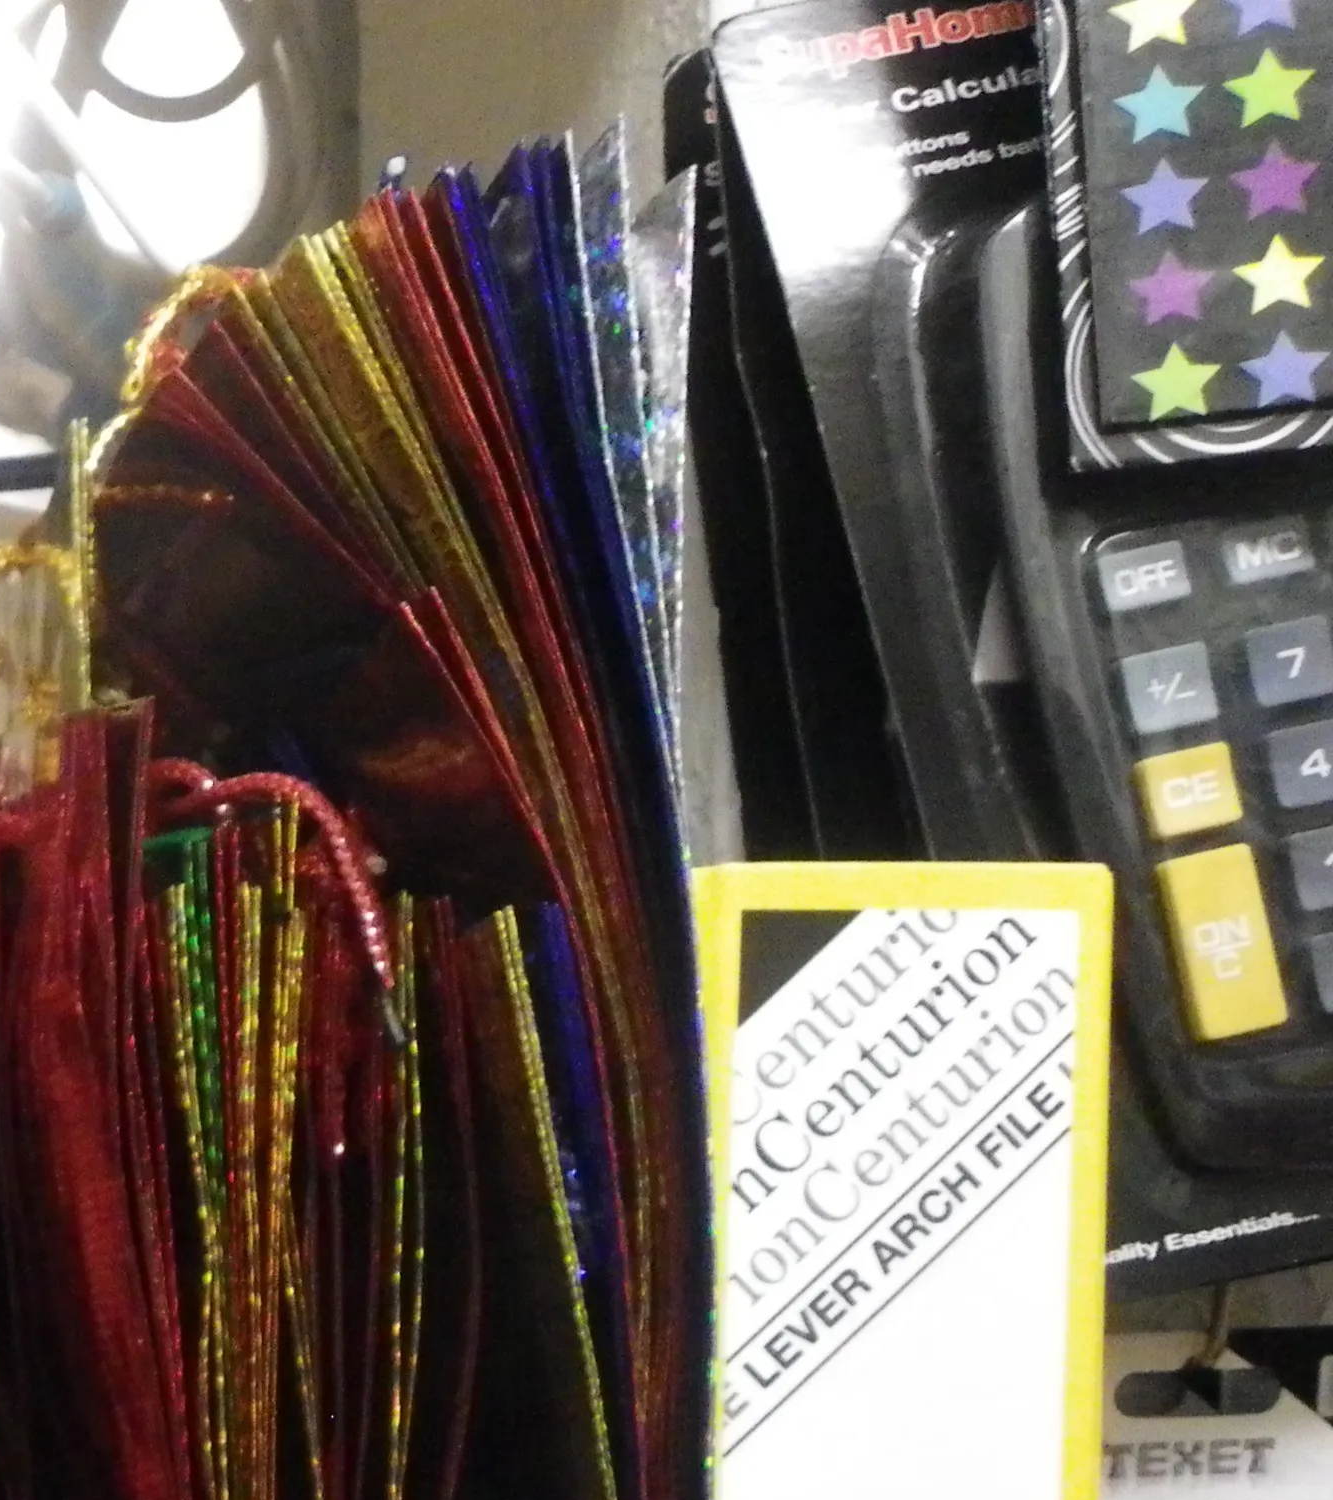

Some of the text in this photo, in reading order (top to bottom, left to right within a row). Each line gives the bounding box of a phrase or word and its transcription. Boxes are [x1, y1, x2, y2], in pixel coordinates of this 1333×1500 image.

[912, 148, 995, 178] needs
[1115, 531, 1303, 597] OFF MC
[1276, 646, 1307, 680] 7
[1162, 748, 1332, 809] CE 4
[742, 1268, 872, 1389] LEVER
[871, 1161, 983, 1276] ARCH
[975, 1080, 1066, 1169] FILE
[1104, 1437, 1276, 1479] TEXET
